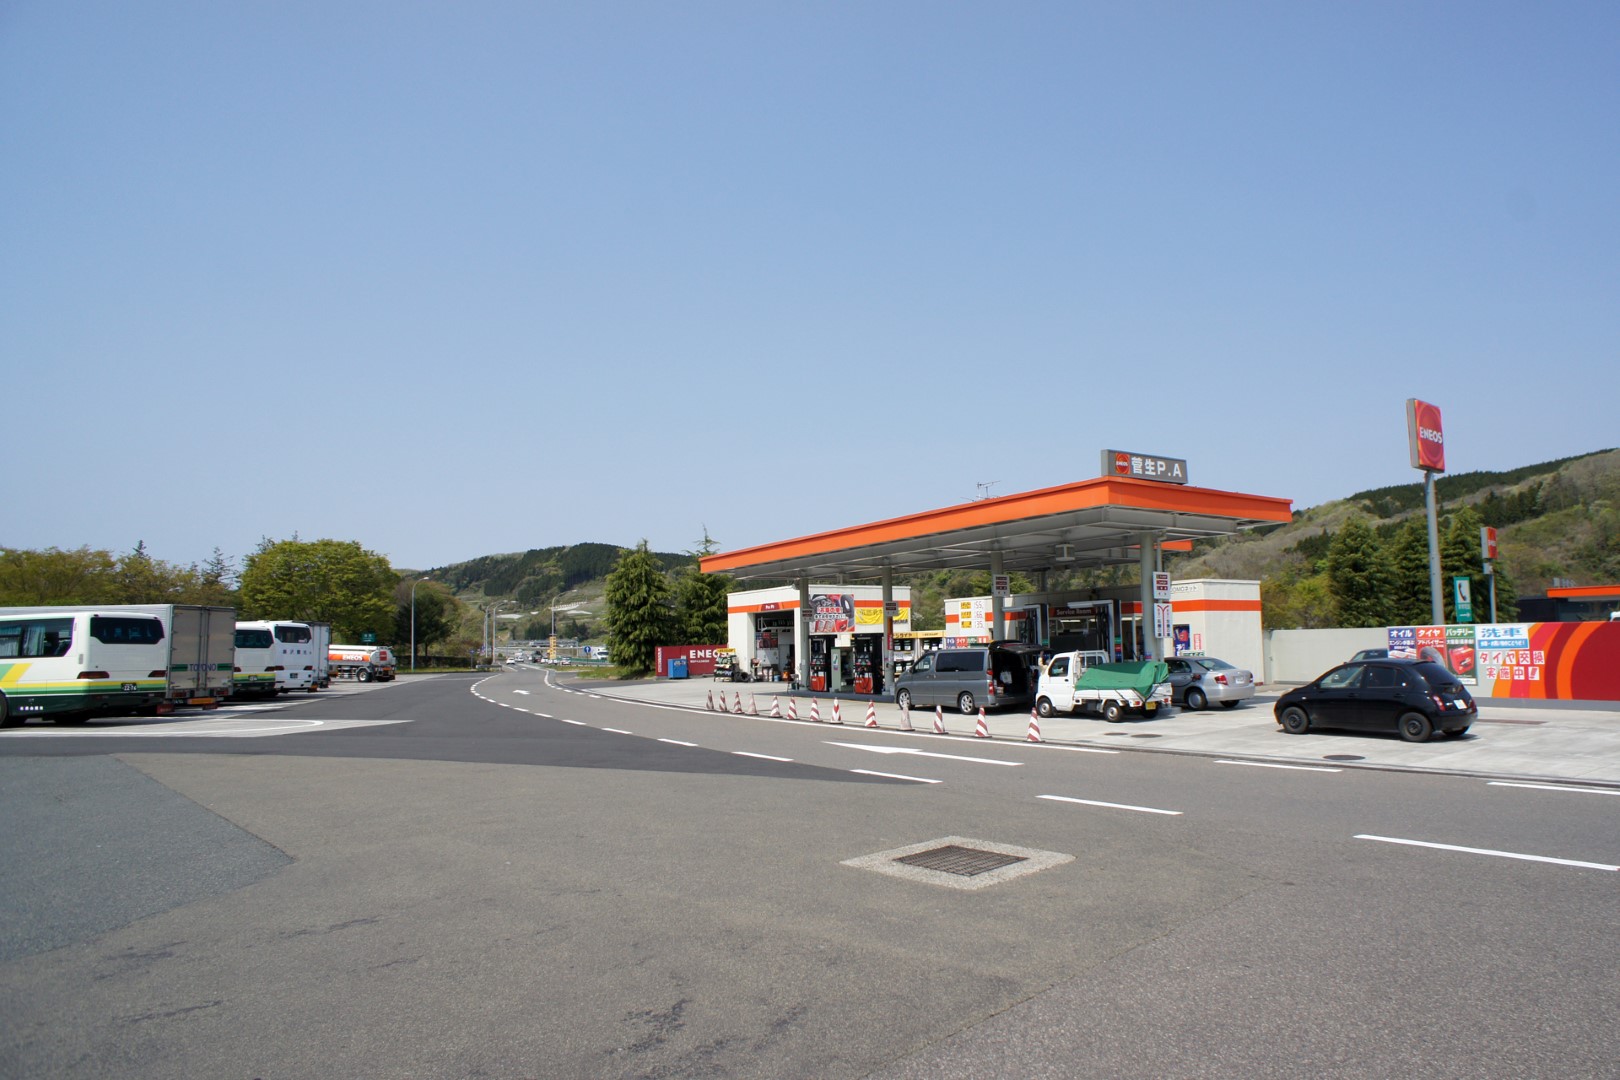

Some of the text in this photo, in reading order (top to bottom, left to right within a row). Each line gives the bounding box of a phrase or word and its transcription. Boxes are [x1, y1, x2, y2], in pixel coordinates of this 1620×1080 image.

[1419, 427, 1443, 444] ENEOS
[1390, 628, 1412, 637] オイル
[1418, 629, 1441, 637] タイヤ
[1446, 628, 1474, 636] バッテリー
[1481, 628, 1522, 637] 洗車
[1480, 652, 1544, 663] タイヤ交換
